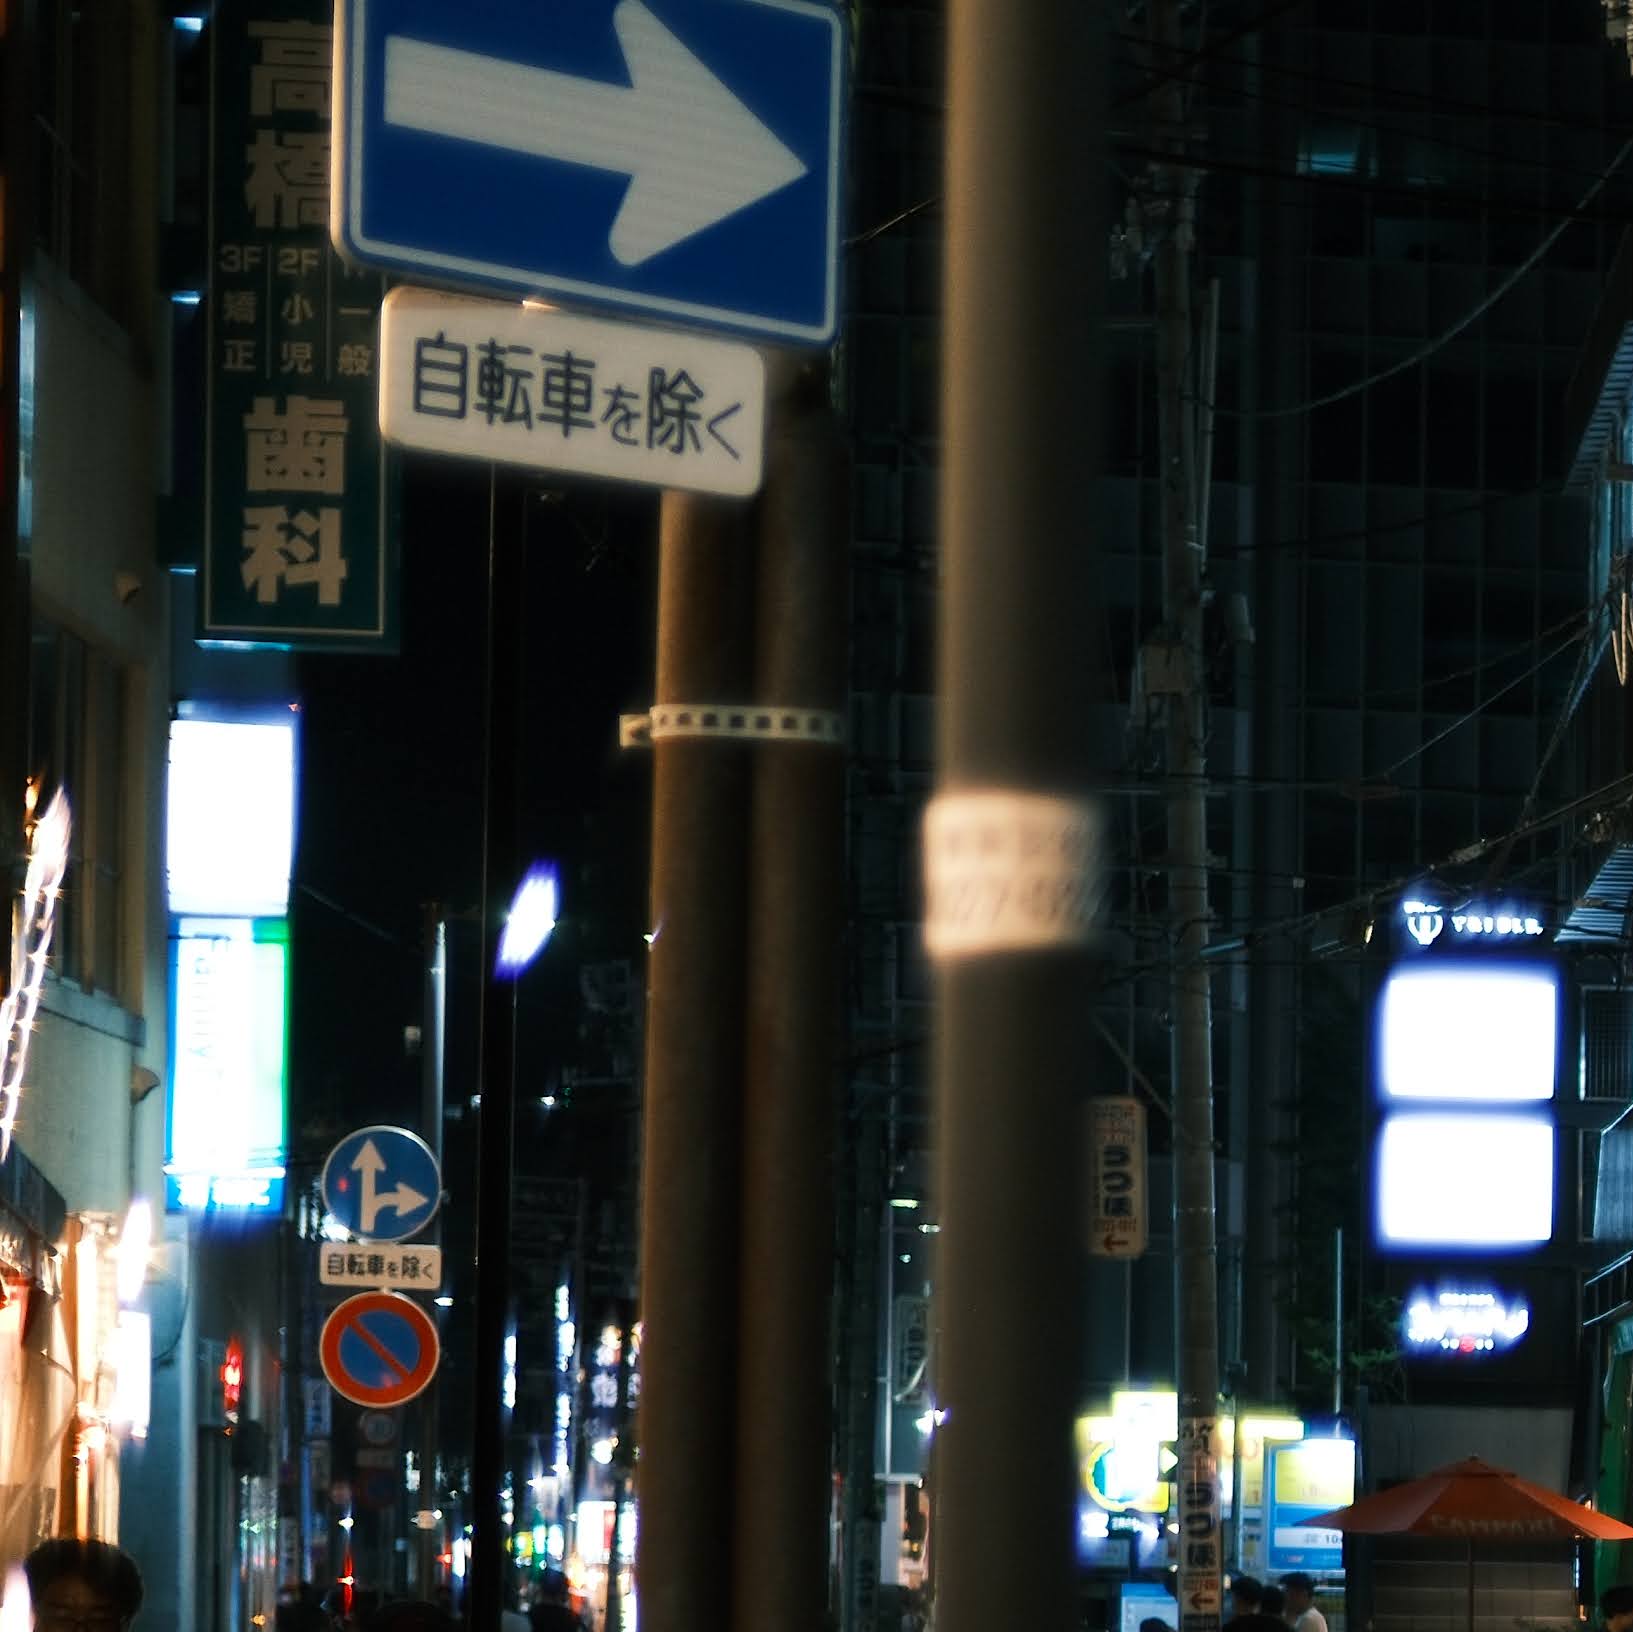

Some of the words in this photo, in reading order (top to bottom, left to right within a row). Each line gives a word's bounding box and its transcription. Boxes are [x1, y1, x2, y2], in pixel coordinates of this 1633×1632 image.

[279, 293, 314, 375] 小児
[412, 331, 743, 463] 自転車を除く
[242, 396, 348, 606] 歯科
[327, 1253, 433, 1281] 自転車を除く
